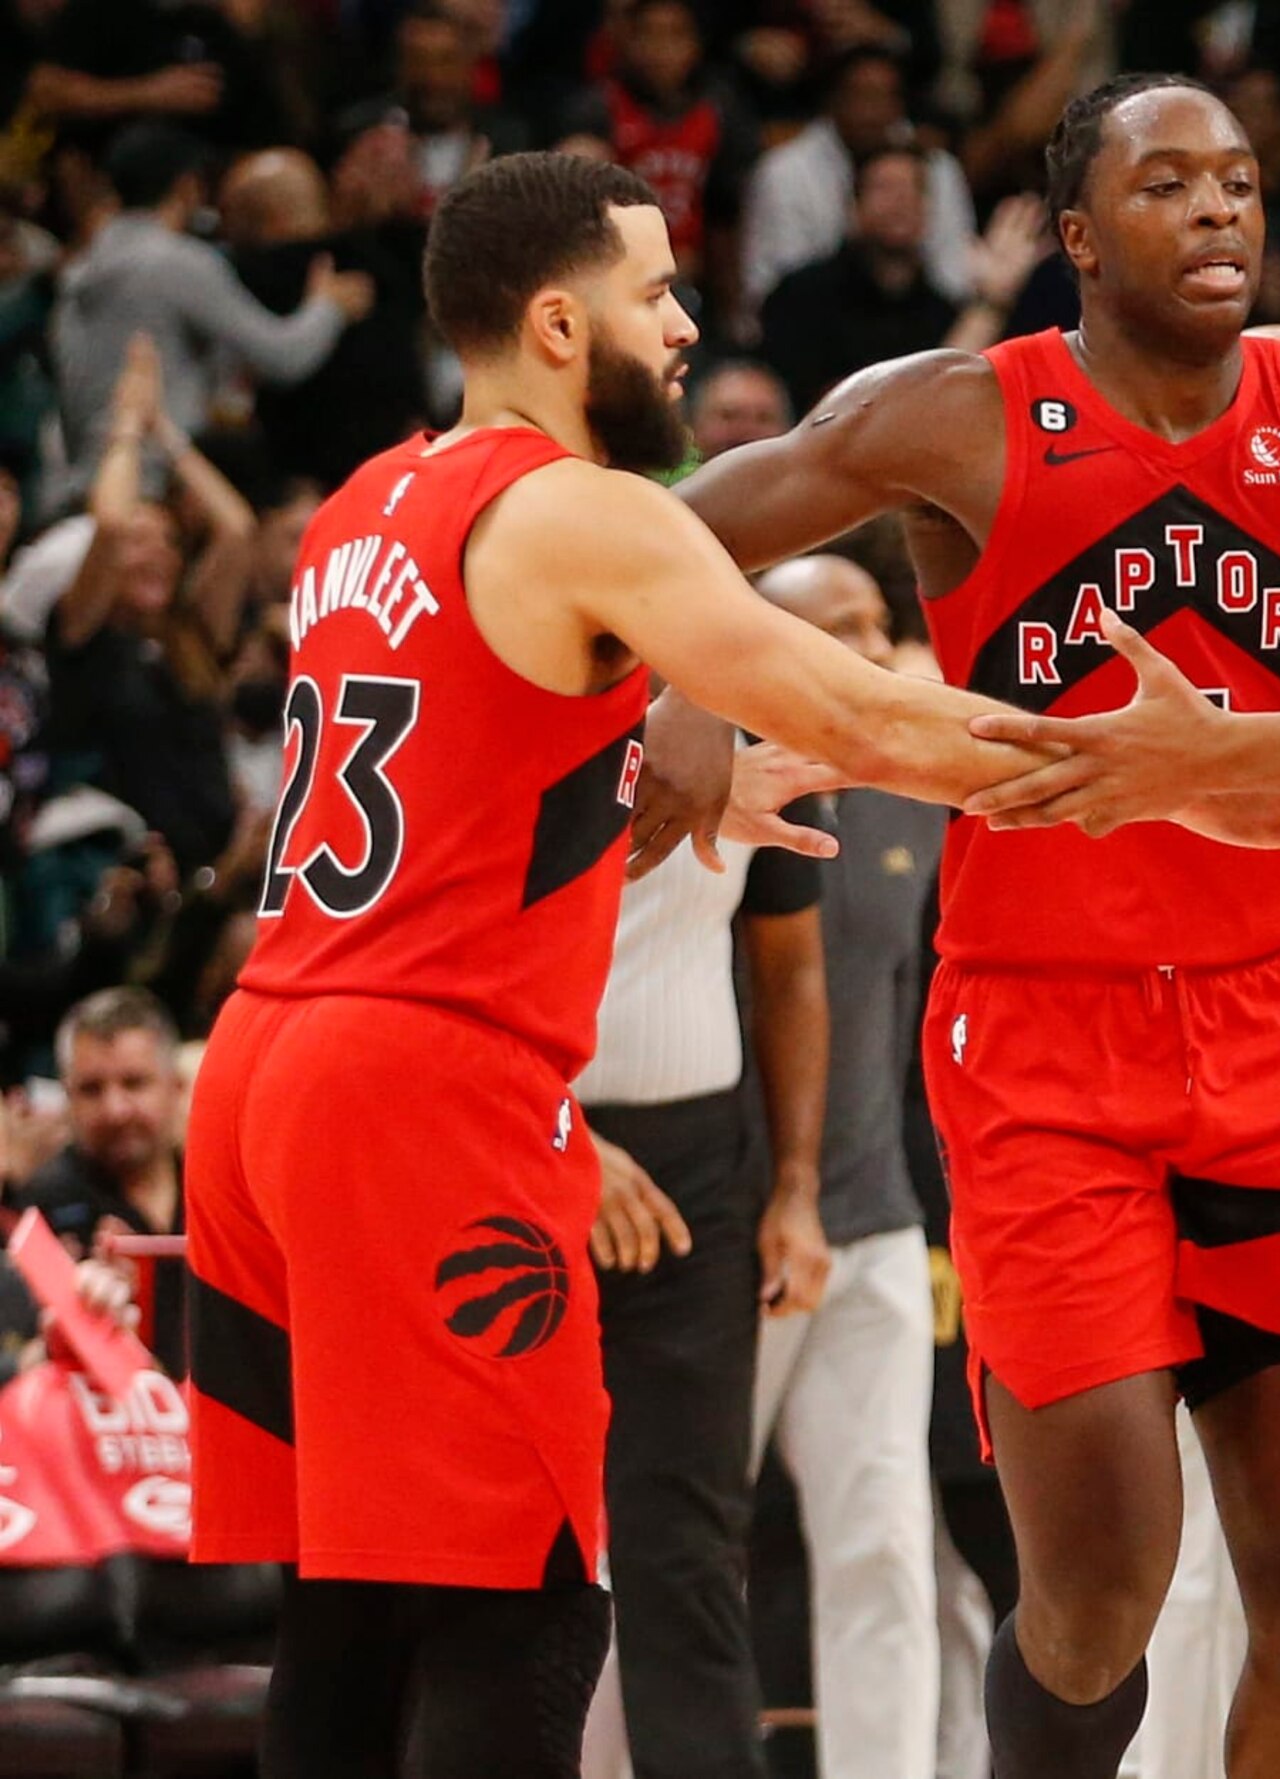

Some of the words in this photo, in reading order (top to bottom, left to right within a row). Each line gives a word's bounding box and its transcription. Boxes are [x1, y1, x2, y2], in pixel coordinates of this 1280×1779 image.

[1040, 402, 1067, 431] 6
[1243, 468, 1277, 485] Sun
[257, 674, 420, 918] 23
